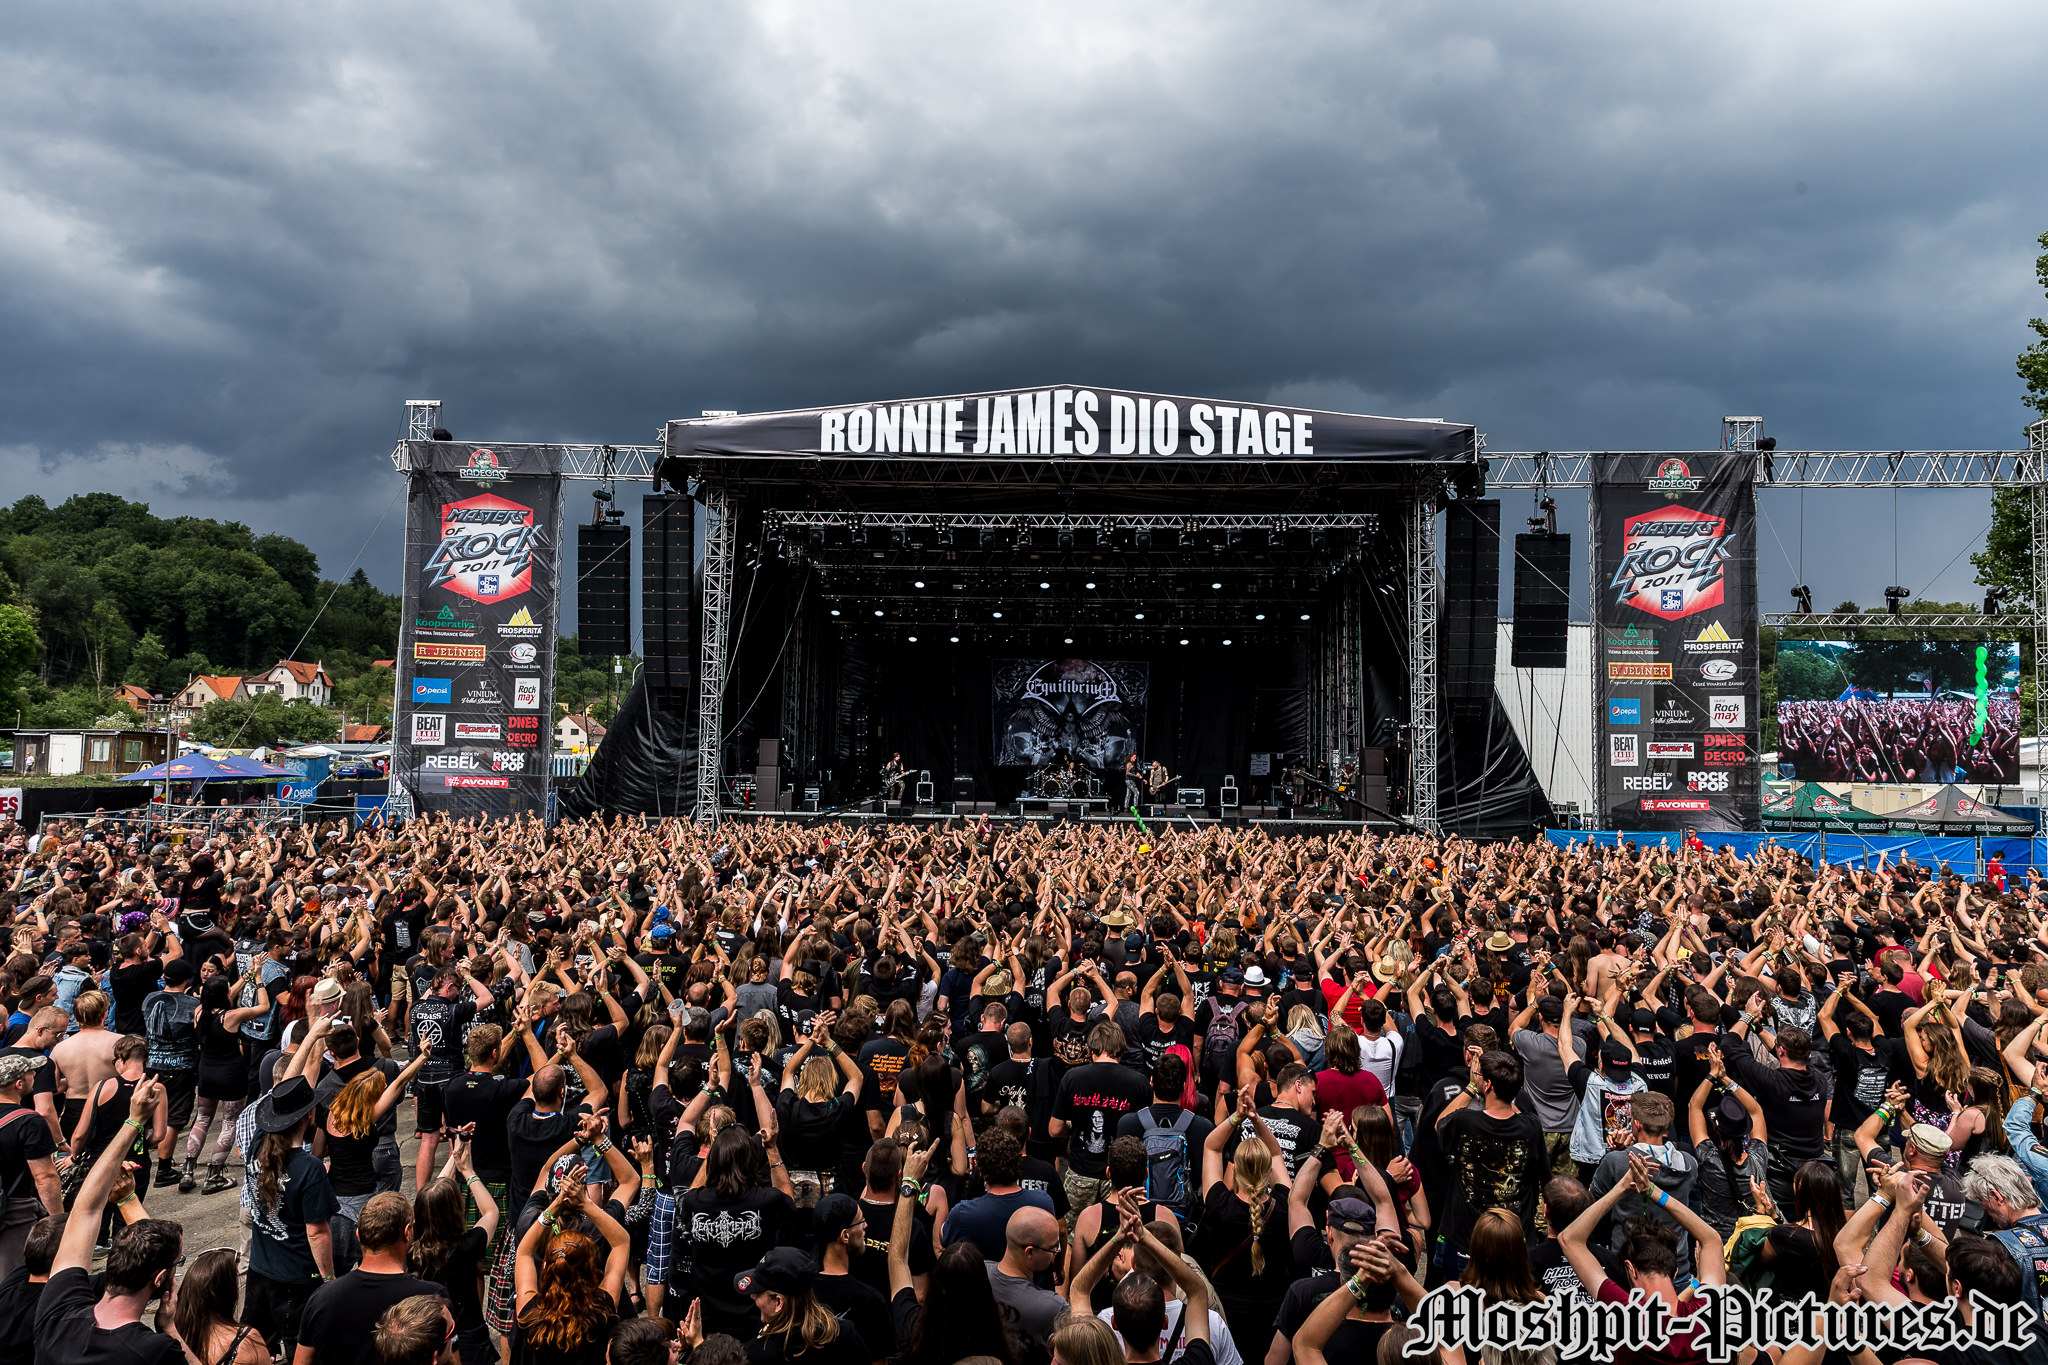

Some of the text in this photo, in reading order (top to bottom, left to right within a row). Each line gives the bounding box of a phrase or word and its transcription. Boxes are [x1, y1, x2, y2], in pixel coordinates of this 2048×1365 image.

[821, 389, 1314, 455] RONNIE JAMES DIO STAGE
[460, 468, 508, 480] RADEGAST
[1649, 479, 1701, 490] RADEGAST
[445, 508, 531, 525] MASTERS
[445, 527, 465, 536] OF
[1627, 521, 1721, 538] MASTERS
[1627, 541, 1647, 551] OF
[422, 524, 543, 588] ROCK
[459, 560, 500, 574] 2017
[1609, 534, 1736, 605] ROCK
[1642, 573, 1684, 589] 2017
[415, 619, 475, 629] Kooperativa
[1608, 637, 1659, 647] Kooperativa
[419, 647, 481, 657] R. JELÍNEK
[1623, 666, 1668, 675] JELÍNEK
[427, 687, 448, 695] pepsi
[467, 690, 498, 698] VINIUM
[518, 685, 536, 694] Rock
[517, 694, 536, 705] max
[1620, 708, 1637, 716] pepsi
[1714, 703, 1740, 712] Rock
[1655, 710, 1690, 718] VINIUM
[1713, 712, 1739, 724] max
[416, 716, 442, 731] BEAT
[508, 717, 539, 729] DNES
[457, 724, 499, 735] Spark
[507, 733, 537, 743] DECRO
[1614, 736, 1635, 751] BEAT
[1704, 734, 1746, 747] DNES
[1648, 744, 1693, 753] Spark
[425, 755, 480, 769] REBEL
[493, 752, 525, 762] ROCK
[1704, 751, 1746, 762] DECRO
[1687, 771, 1729, 782] ROCK
[1623, 776, 1673, 790] REBEL
[293, 787, 314, 799] pepsi
[416, 1012, 442, 1020] CRASS
[1647, 1072, 1671, 1080] REWOLF
